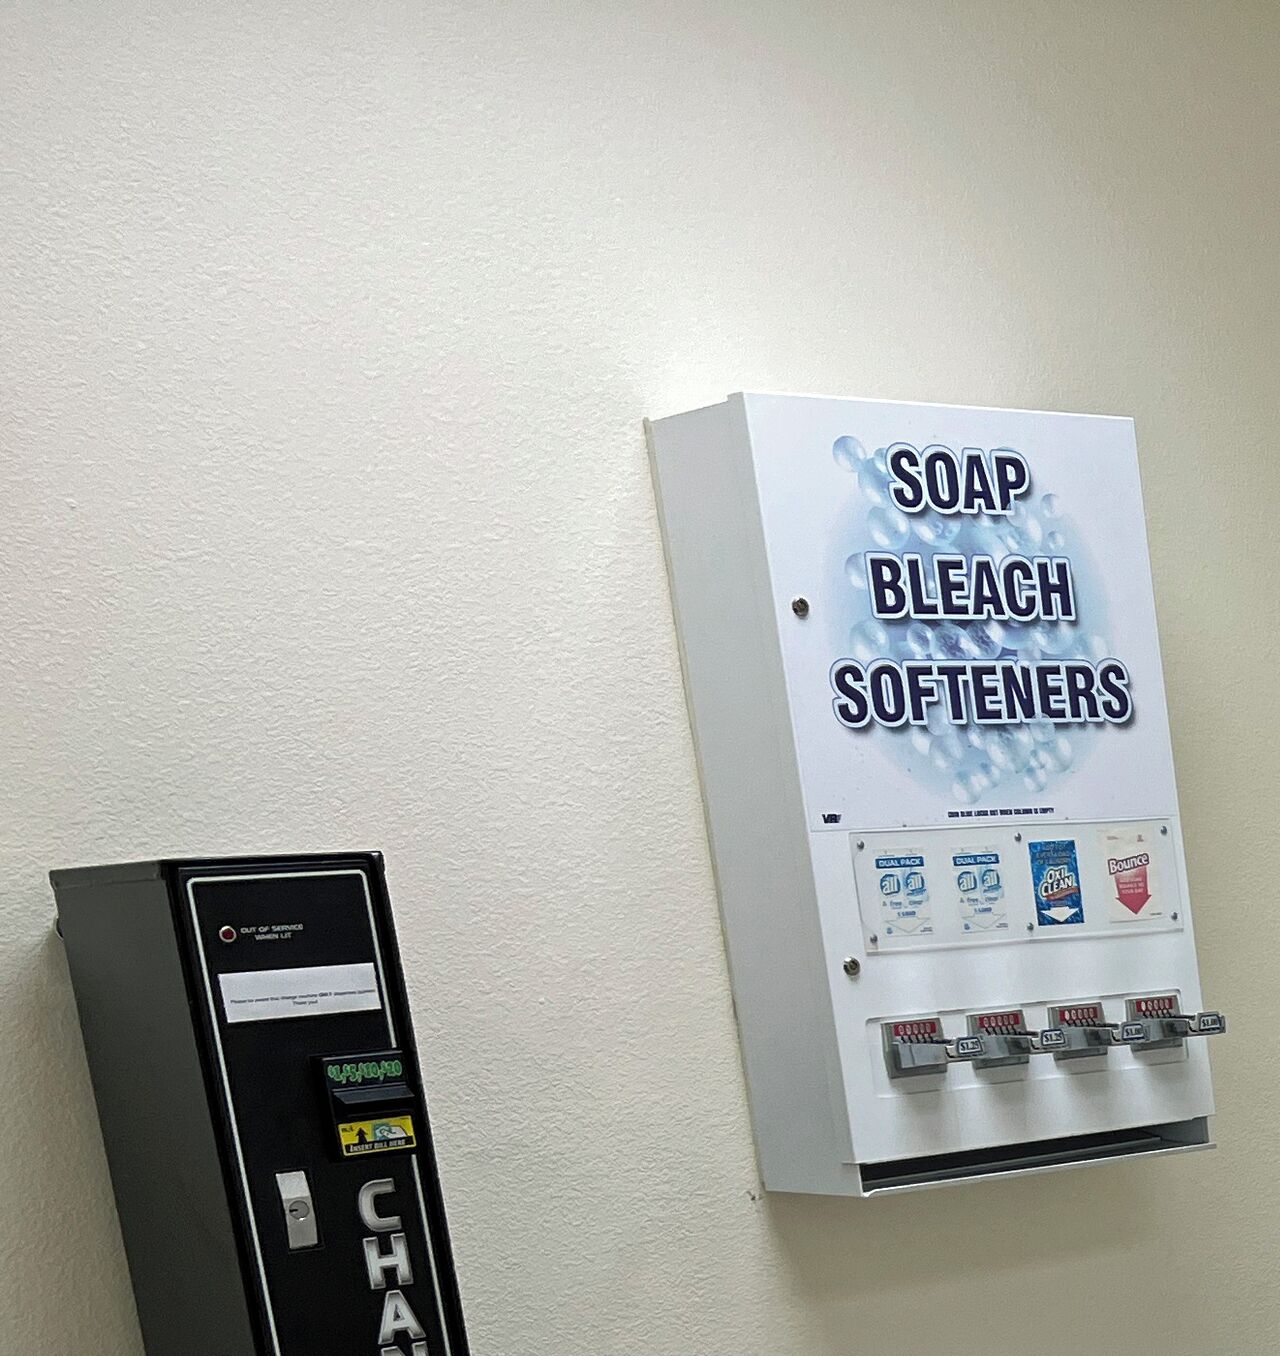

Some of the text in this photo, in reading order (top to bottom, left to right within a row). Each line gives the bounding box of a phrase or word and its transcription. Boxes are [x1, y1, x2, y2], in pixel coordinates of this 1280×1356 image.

[889, 447, 1030, 514] SOAP
[870, 556, 1075, 619] BLEACH
[834, 662, 1131, 725] SOFTENERS
[900, 858, 921, 866] PACK
[956, 855, 997, 865] DUAL PACK
[1109, 854, 1149, 874] Bounce
[881, 875, 900, 895] all
[907, 873, 923, 890] all
[960, 872, 976, 892] all
[983, 870, 998, 887] all
[1046, 868, 1066, 884] OXI
[1041, 876, 1073, 896] CLEAN
[240, 923, 304, 934] OUT OF SERVICE
[254, 932, 292, 941] WHEN LIT
[1043, 1032, 1063, 1042] $1.25
[960, 1041, 979, 1051] $1.25
[350, 1139, 406, 1153] INSERT BILL HERE
